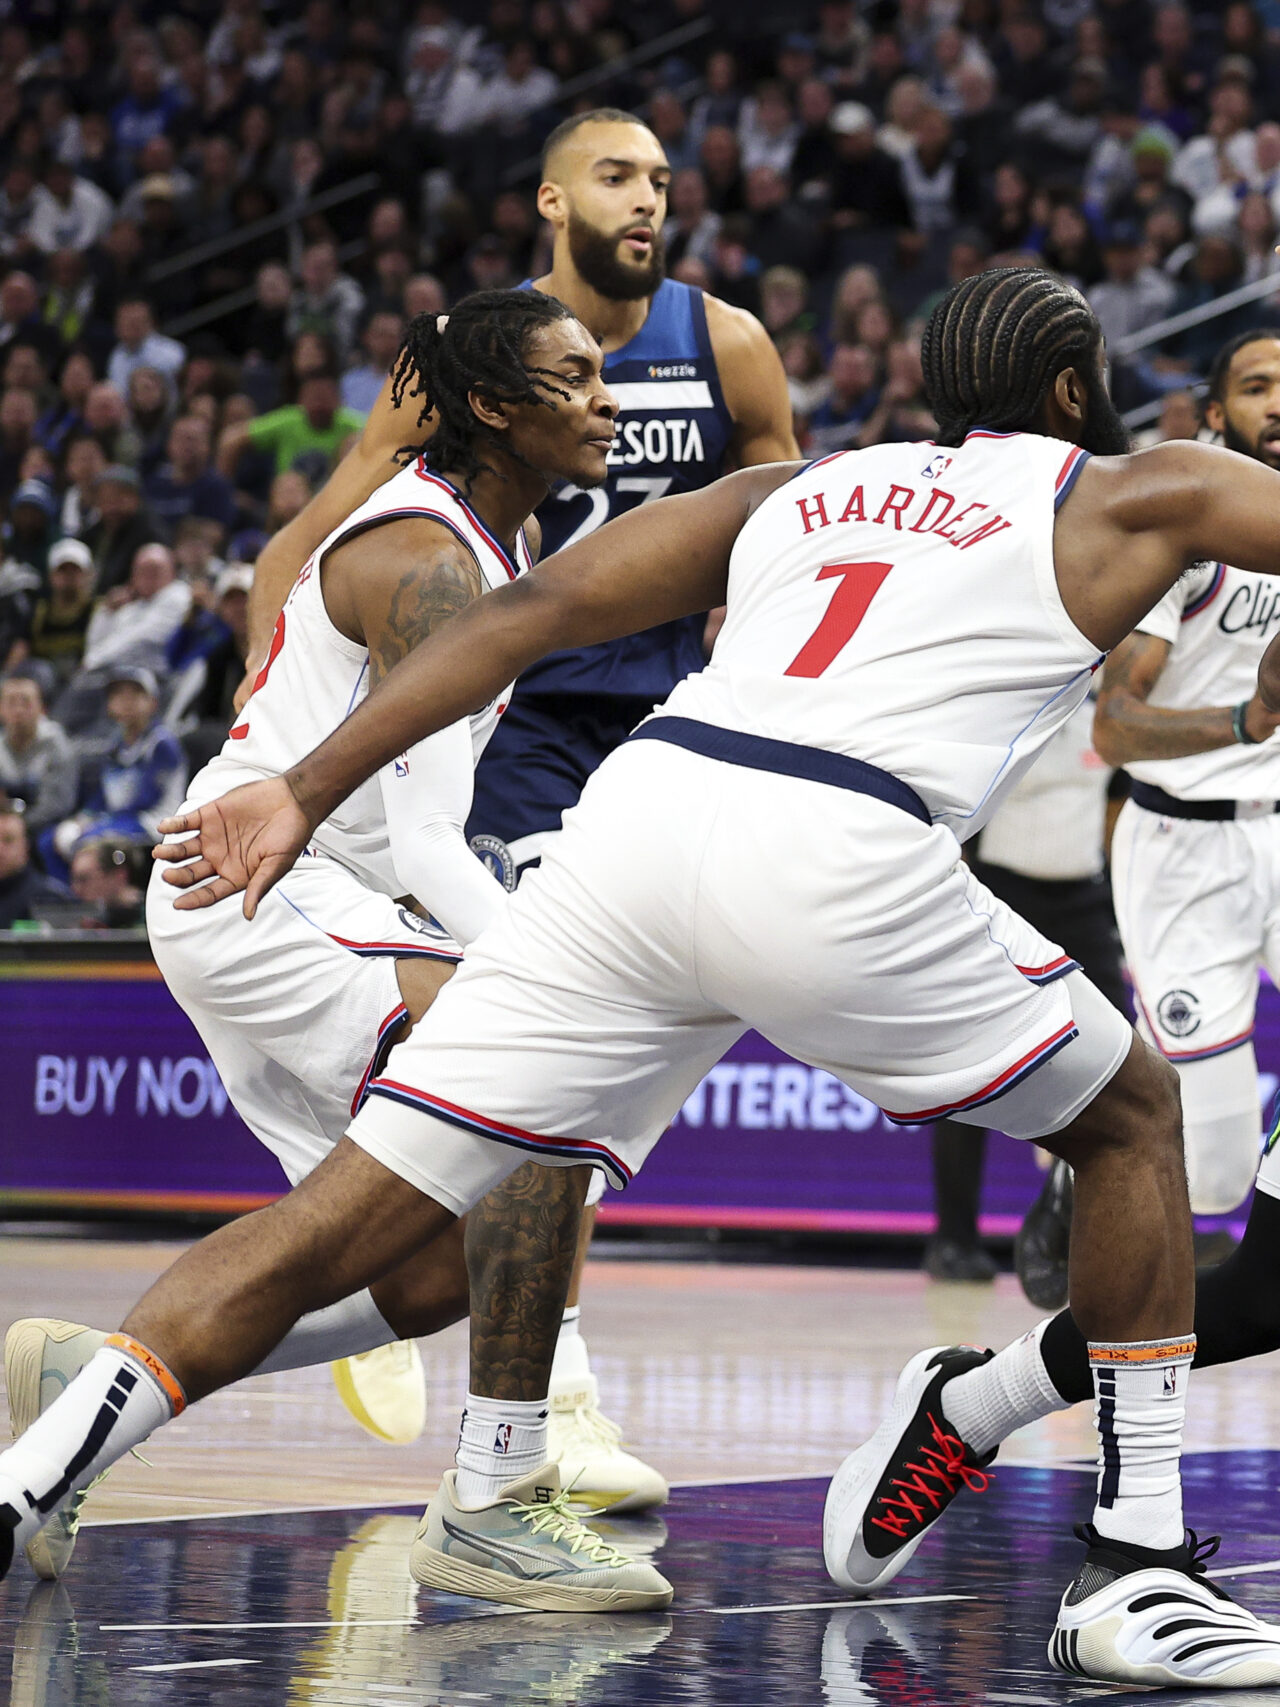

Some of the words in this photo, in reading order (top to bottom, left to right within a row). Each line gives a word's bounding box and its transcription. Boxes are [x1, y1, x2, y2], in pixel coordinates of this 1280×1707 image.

[656, 366, 697, 378] sezzle
[605, 418, 705, 466] ESOTA
[795, 483, 1013, 551] HARDEN
[783, 561, 895, 679] 1
[34, 1054, 128, 1117] BUY
[672, 1063, 897, 1133] NTERES
